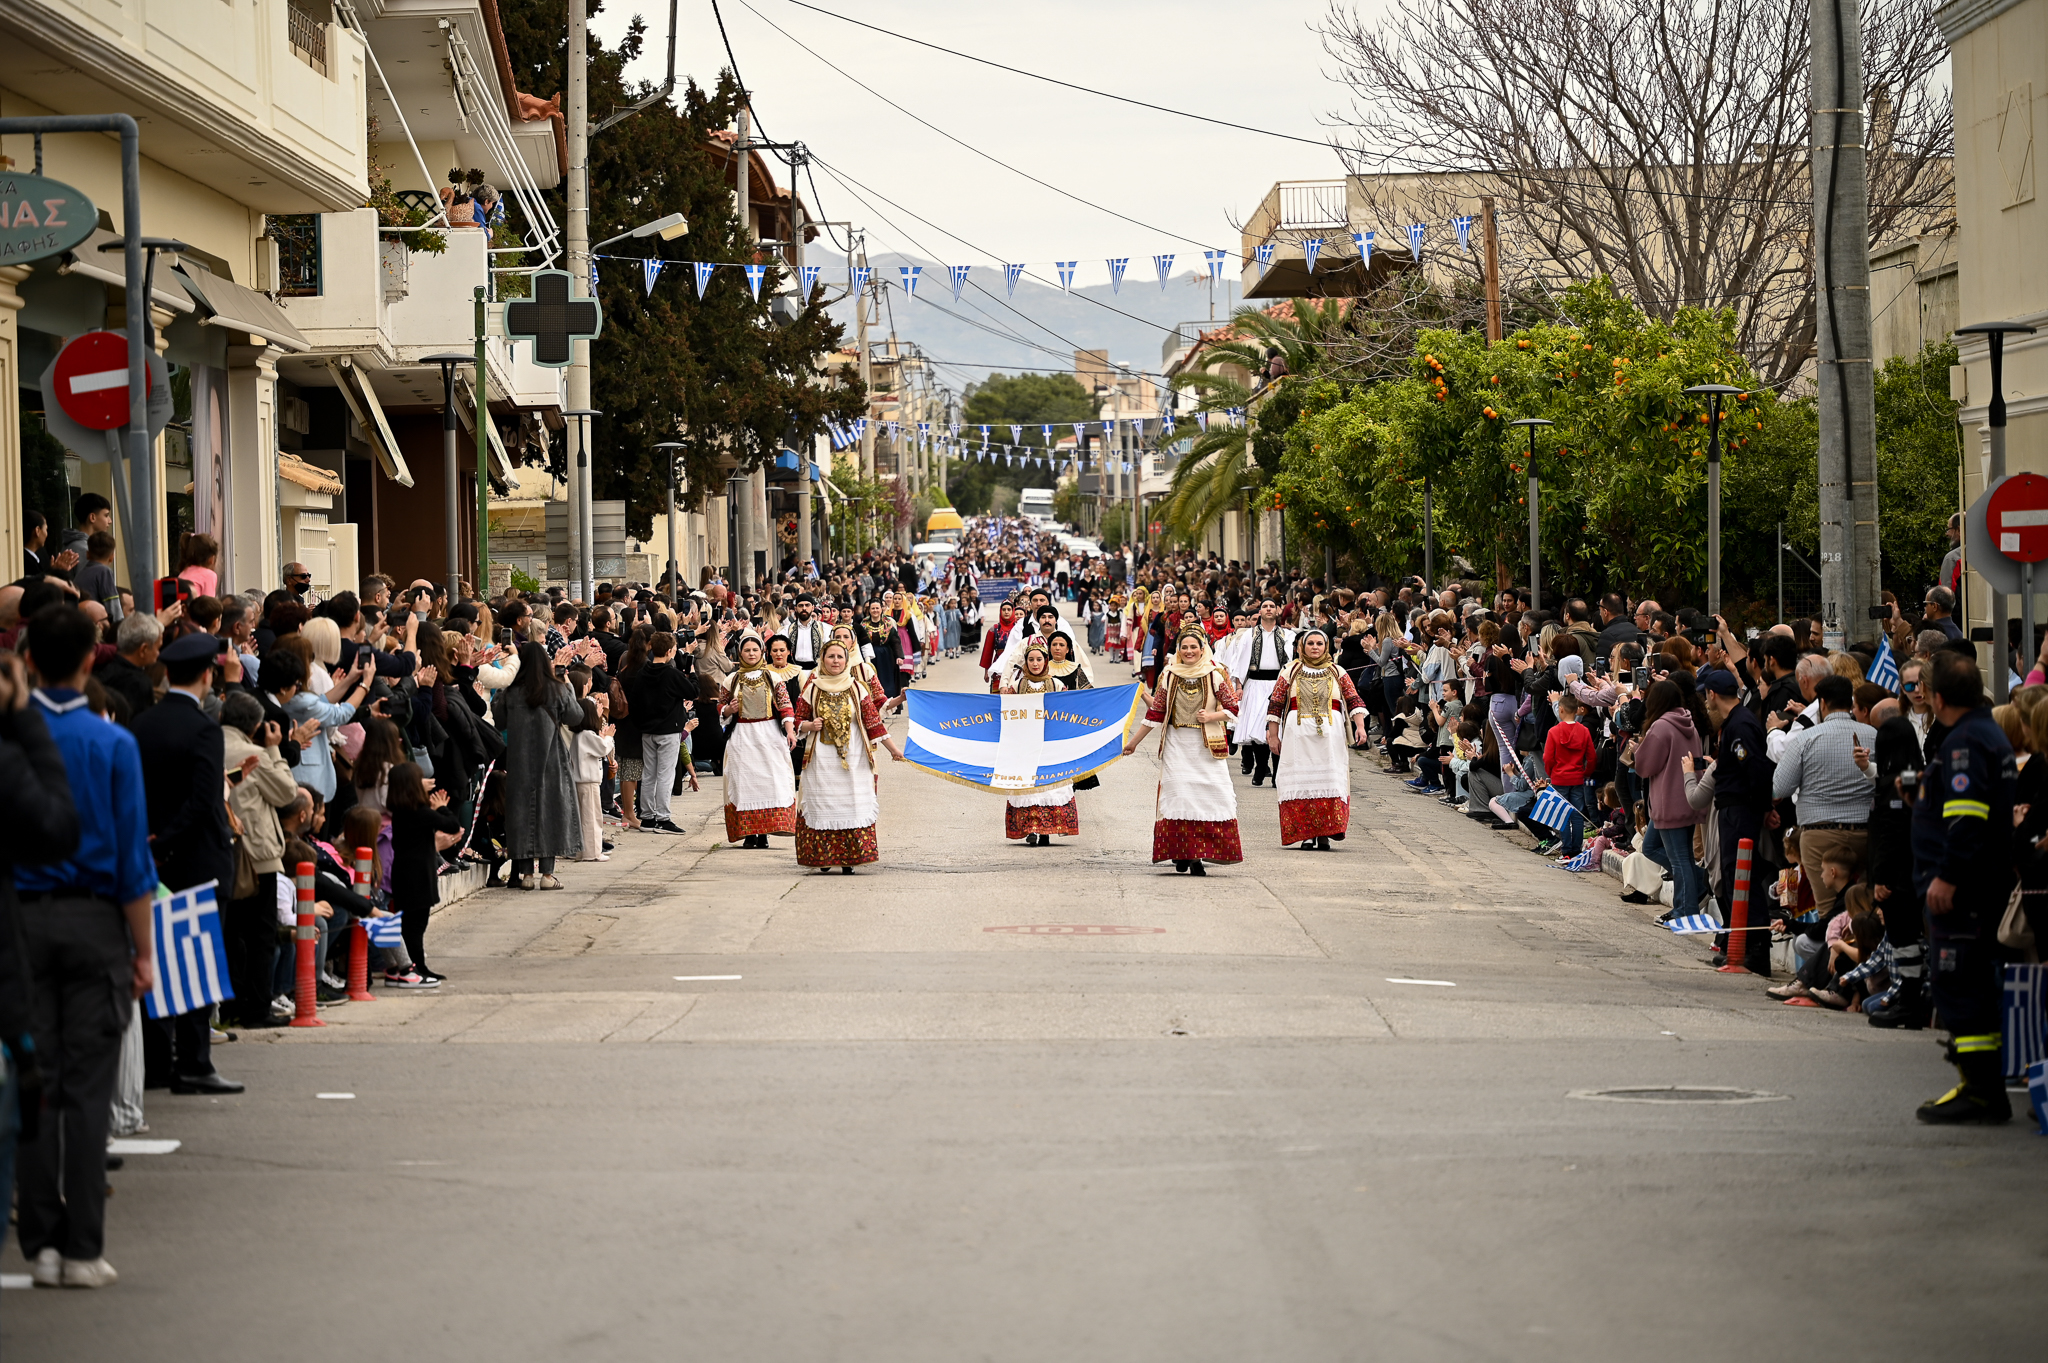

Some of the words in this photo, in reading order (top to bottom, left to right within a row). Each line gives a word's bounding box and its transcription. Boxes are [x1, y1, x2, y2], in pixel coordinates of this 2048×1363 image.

[0, 232, 59, 257] ΑΦΗΣ
[939, 712, 993, 730] ΛΥΚΕΙΟΝ
[1000, 709, 1028, 720] ΤΩΝ
